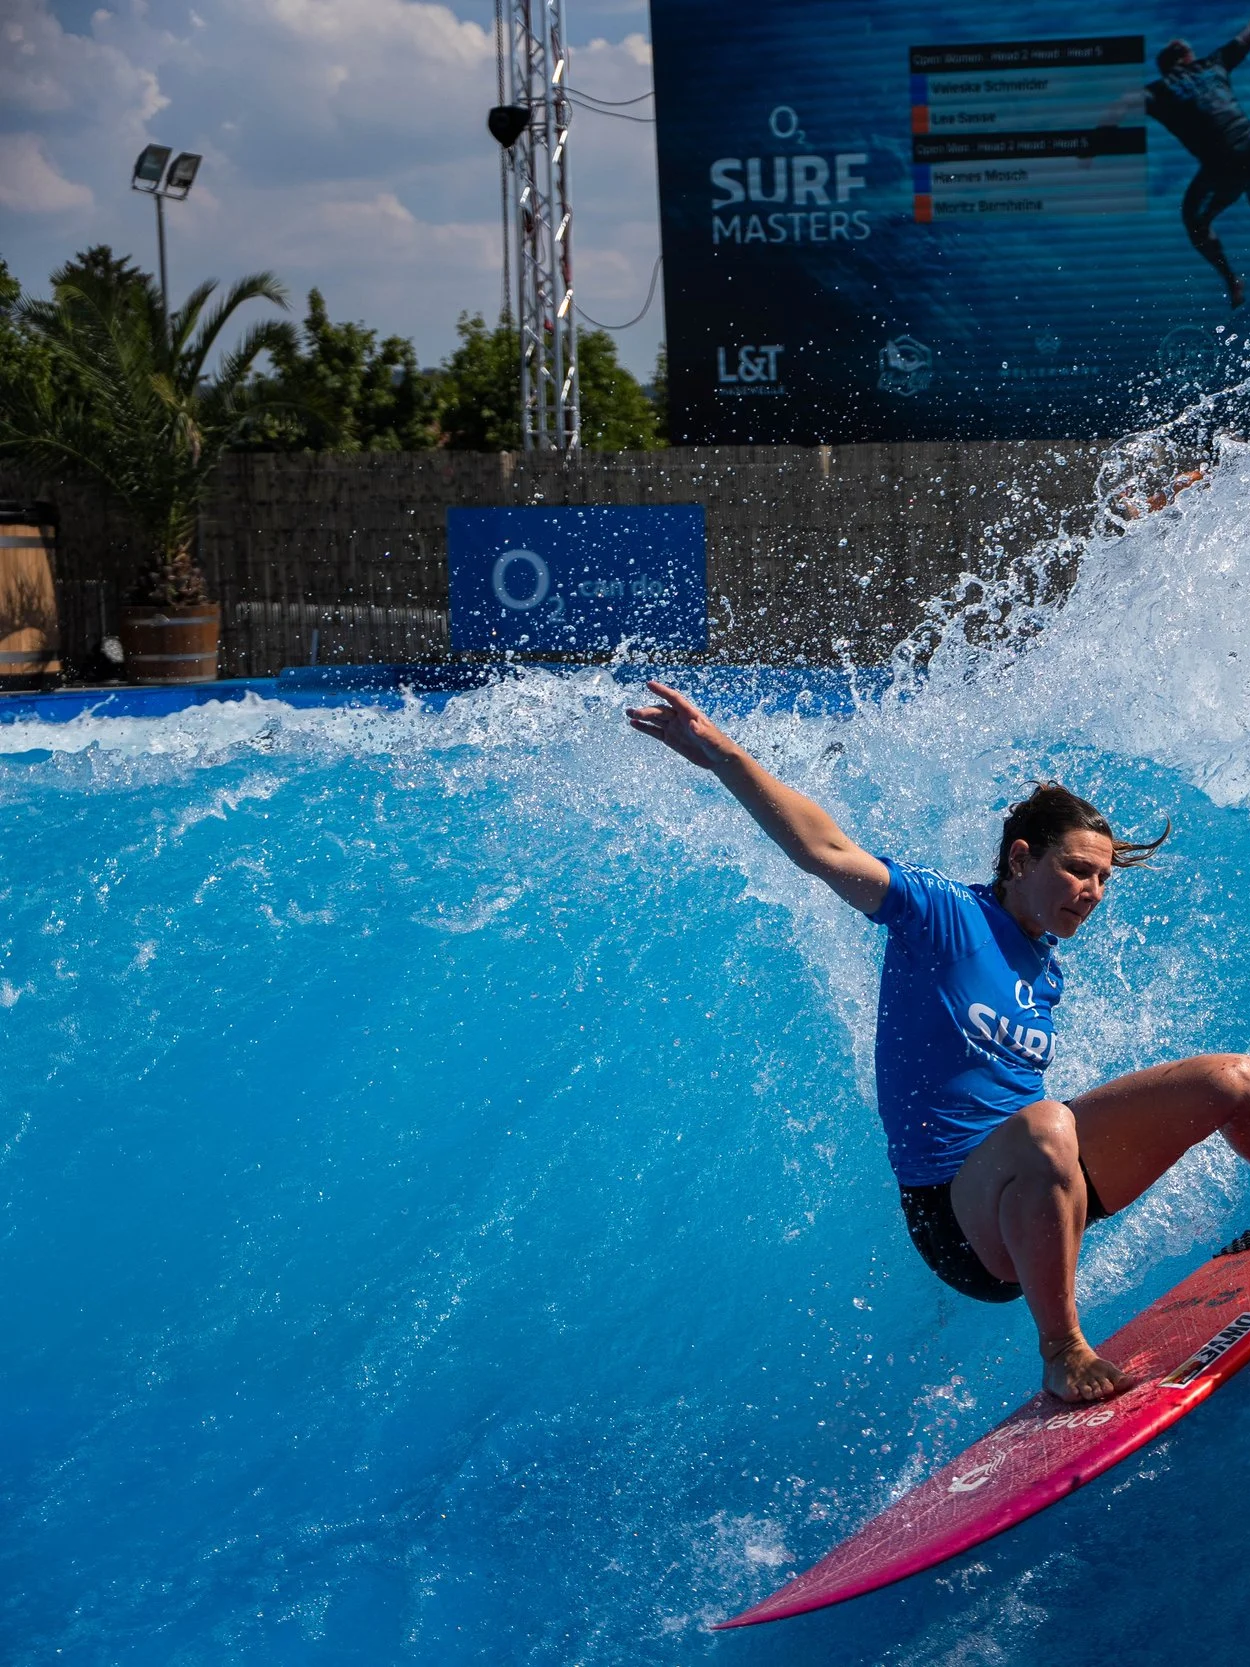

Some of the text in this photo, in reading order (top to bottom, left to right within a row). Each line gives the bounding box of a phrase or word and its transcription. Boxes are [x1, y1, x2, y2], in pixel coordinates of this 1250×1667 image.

[710, 153, 869, 210] SURF
[712, 210, 871, 244] MASTERS
[717, 345, 784, 382] L&T
